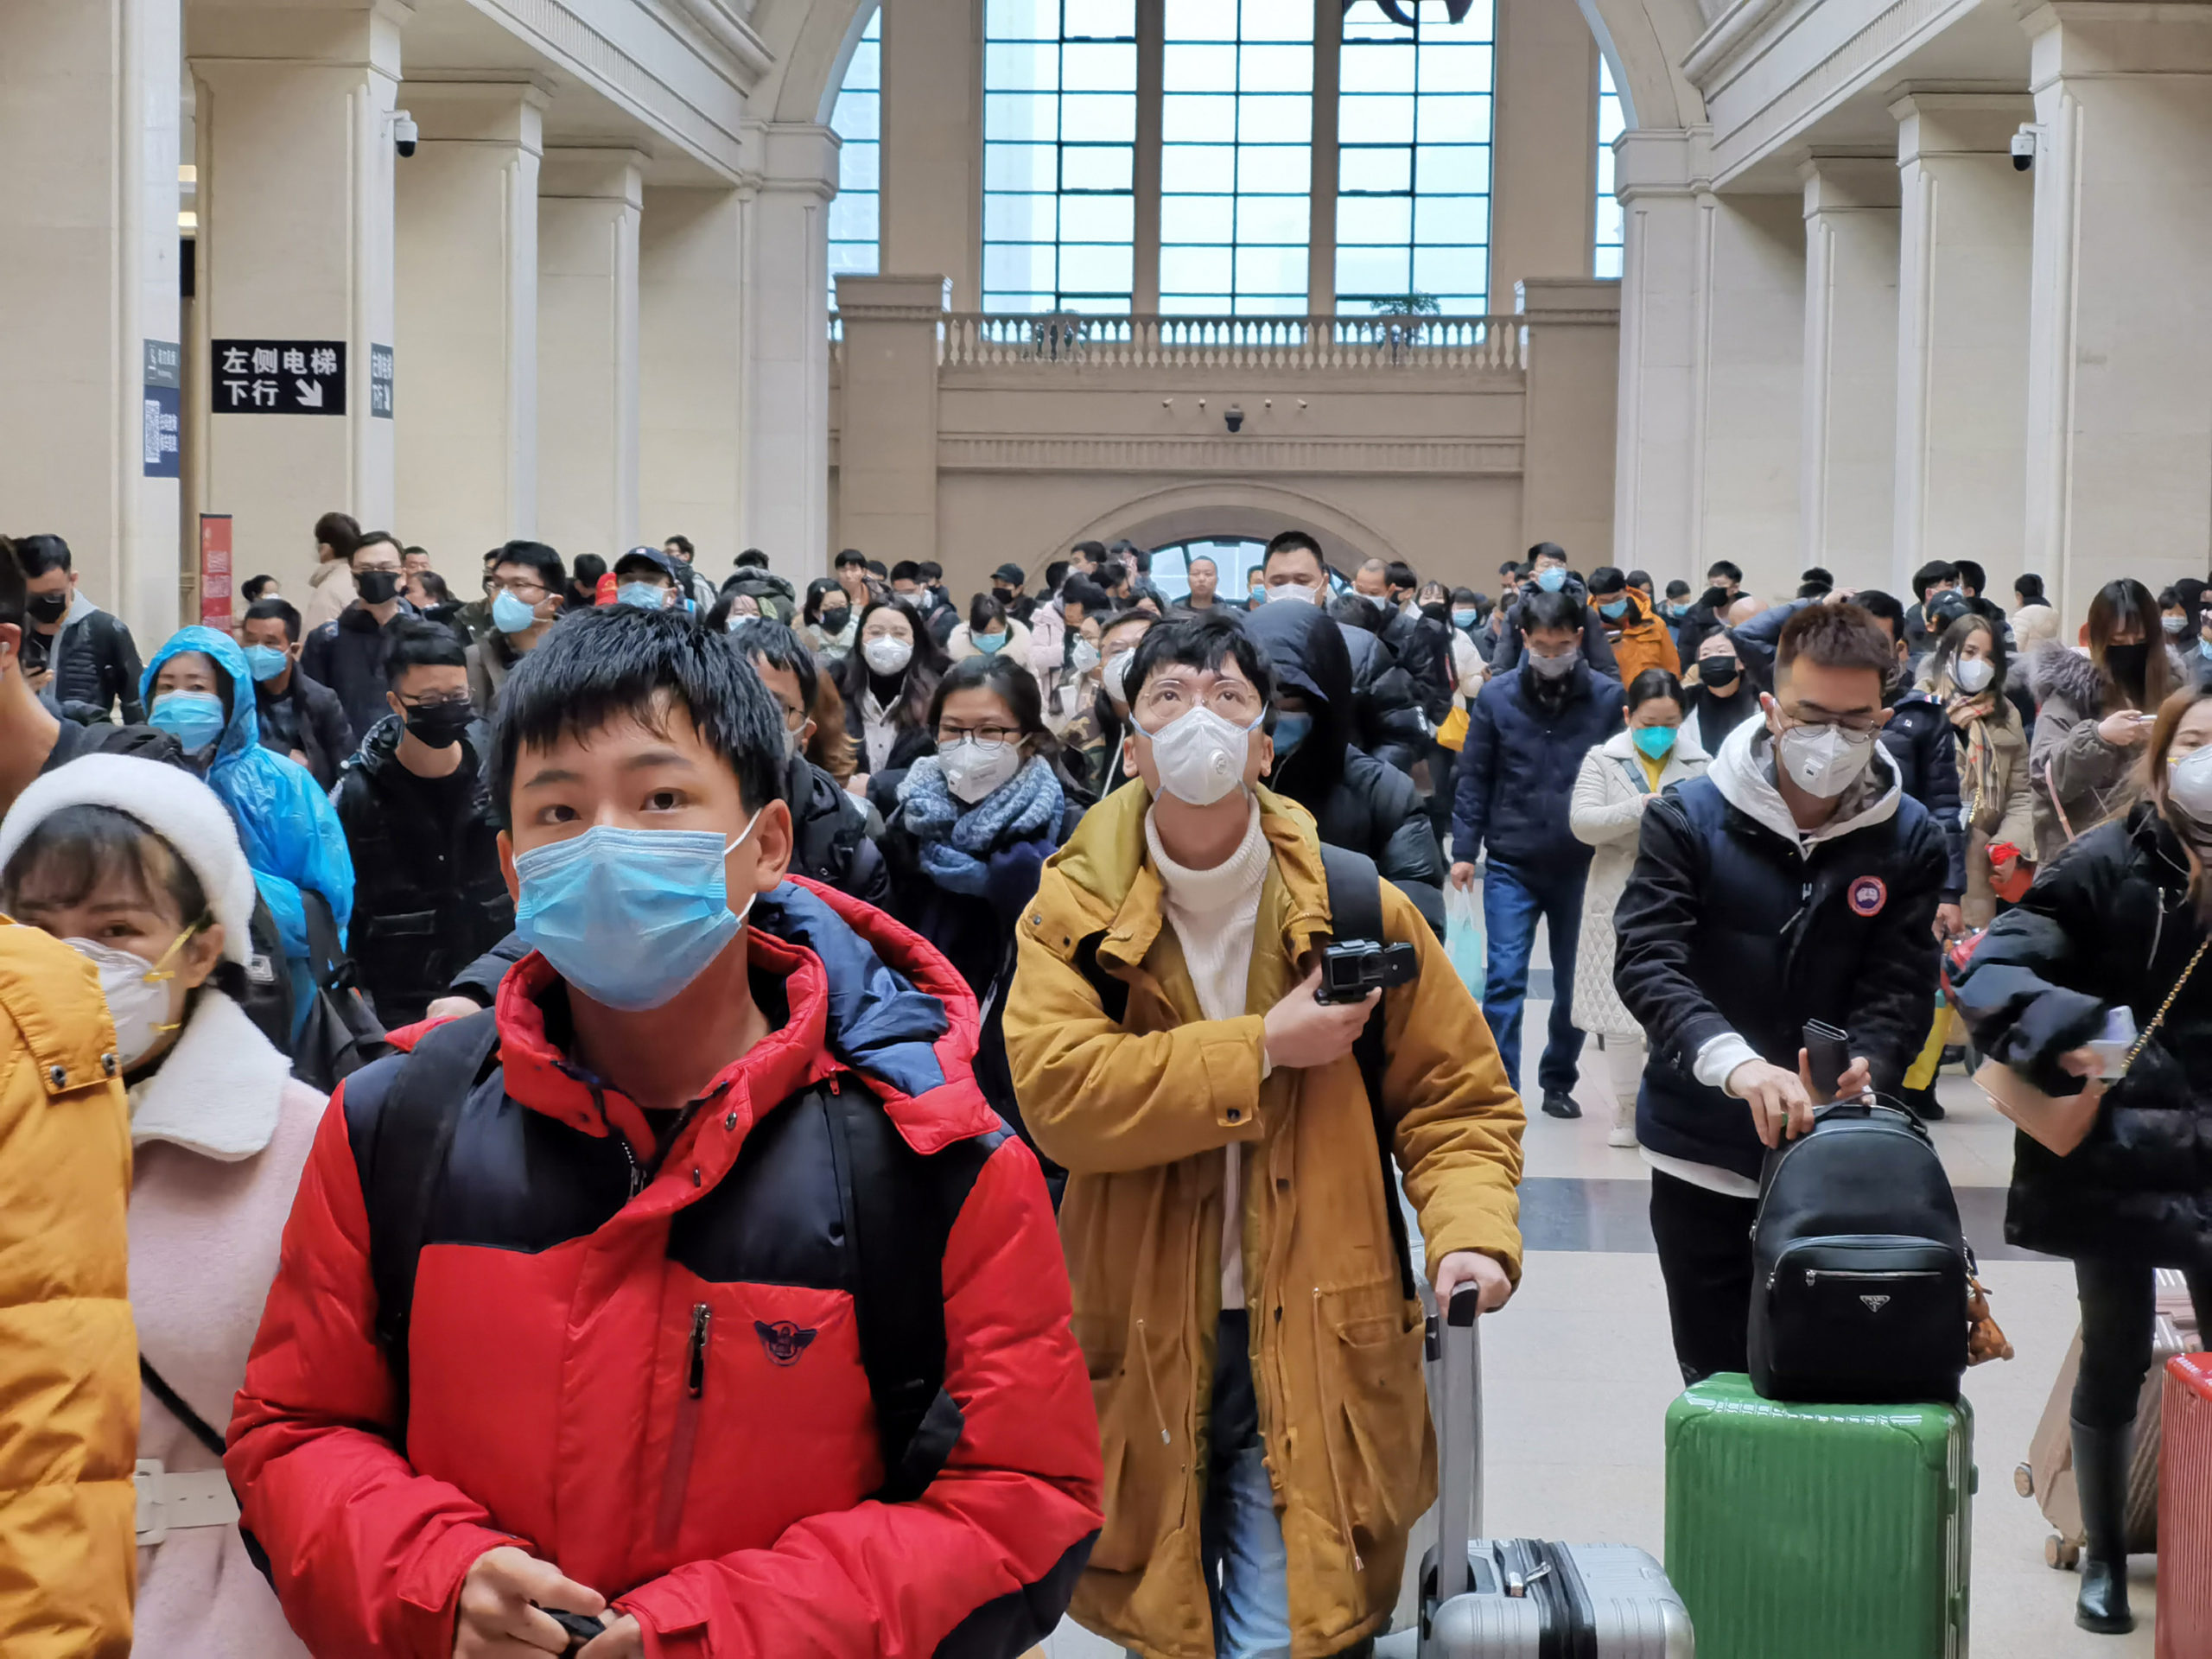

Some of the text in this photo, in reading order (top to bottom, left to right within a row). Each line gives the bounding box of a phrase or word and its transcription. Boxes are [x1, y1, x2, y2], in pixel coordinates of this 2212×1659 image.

[222, 346, 338, 375] 左侧电梯
[222, 378, 280, 406] 下行
